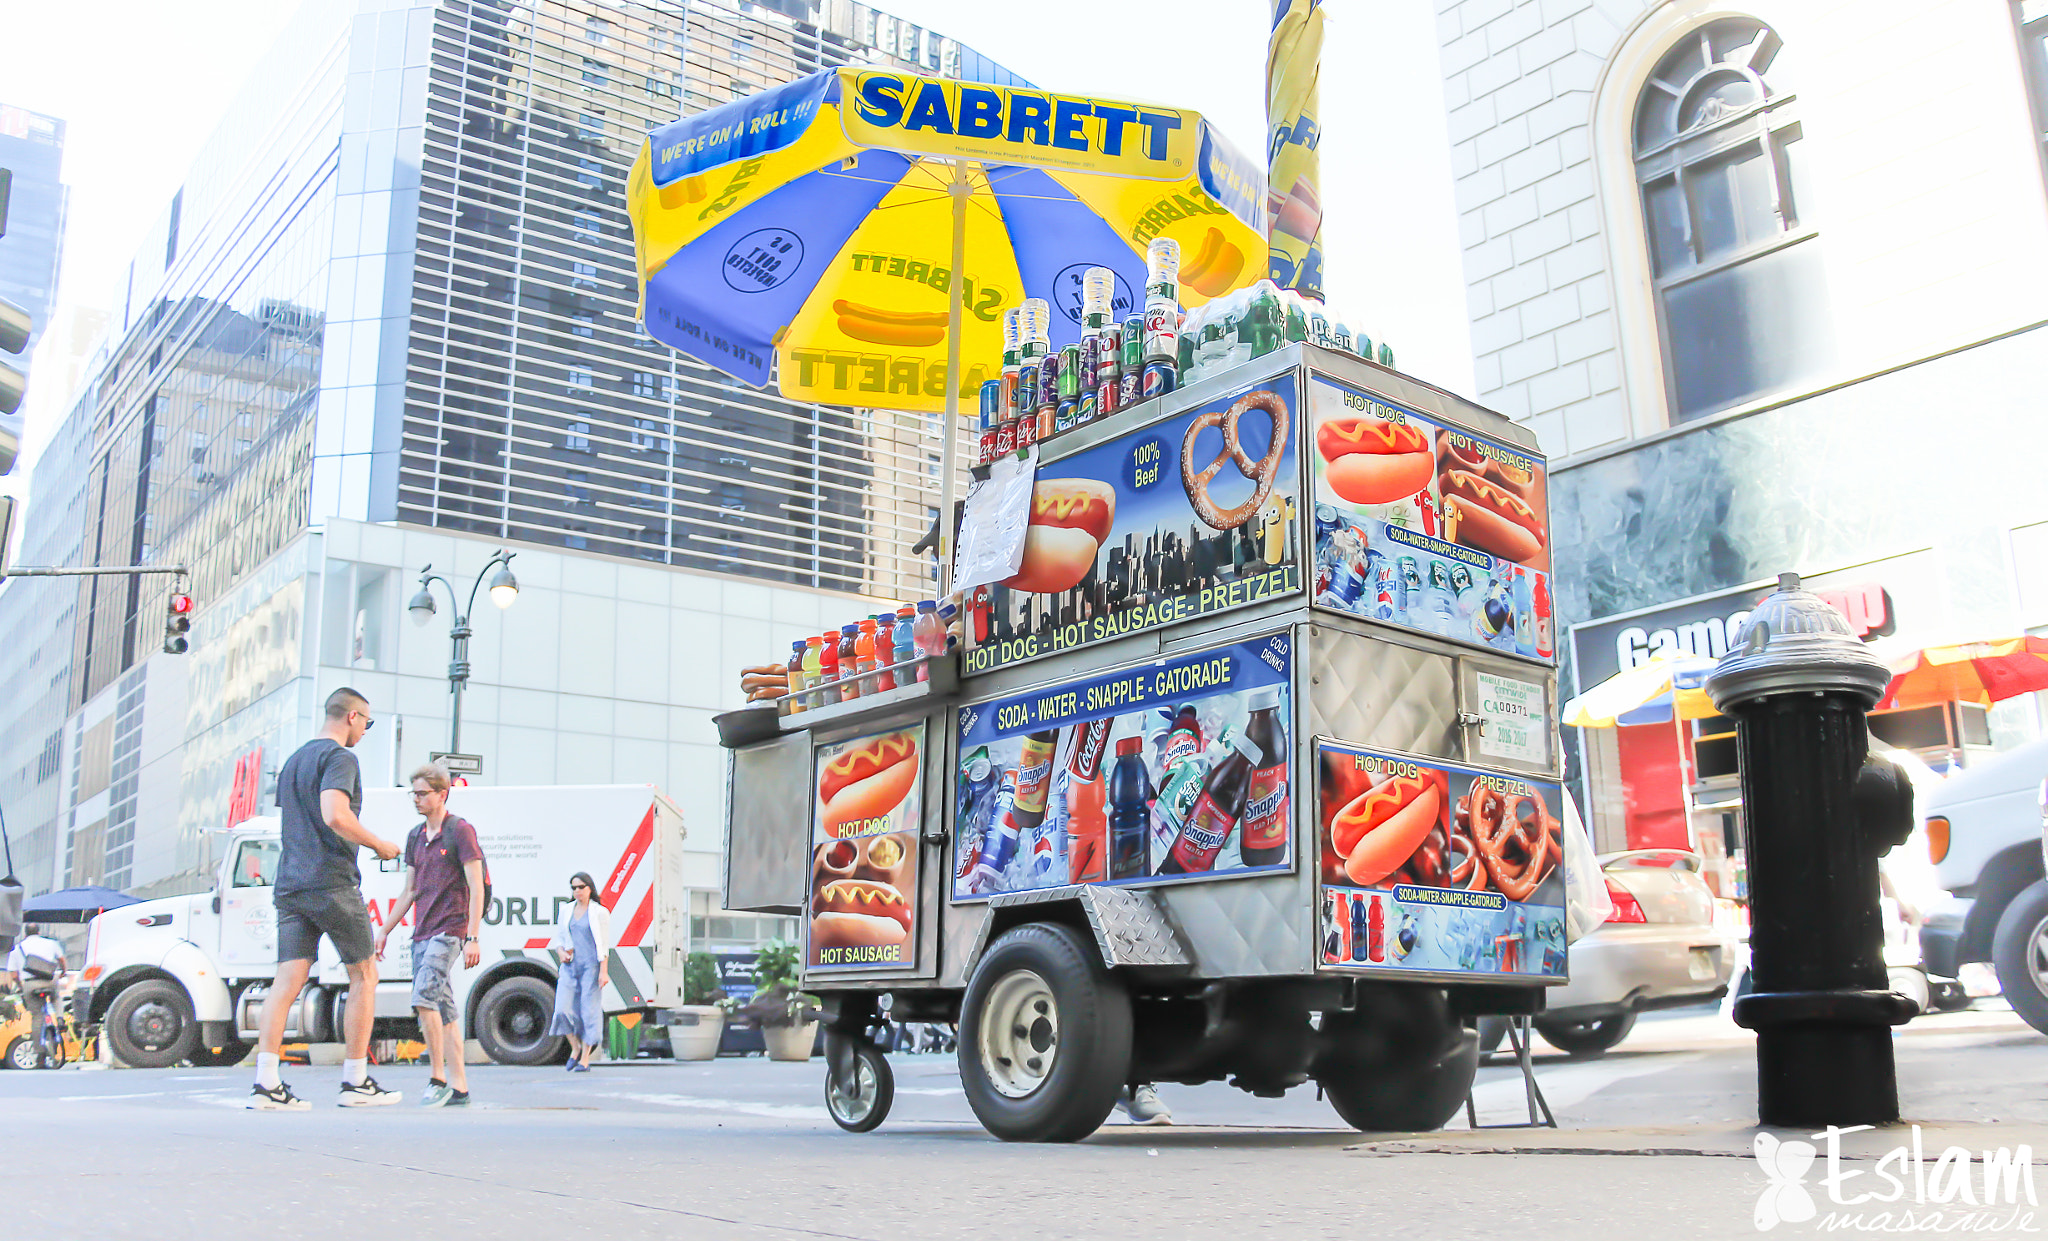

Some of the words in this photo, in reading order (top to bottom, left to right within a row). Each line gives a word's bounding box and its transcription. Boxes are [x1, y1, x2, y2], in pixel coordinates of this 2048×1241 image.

[855, 70, 1181, 161] SABRETT
[661, 135, 706, 165] WE'RE
[709, 124, 732, 147] ON
[734, 121, 745, 139] A
[749, 109, 788, 134] ROLL
[1343, 390, 1373, 414] HOT
[1376, 402, 1406, 426] DOG
[1133, 440, 1160, 467] 100%
[1447, 430, 1473, 451] HOT
[1475, 440, 1533, 473] SAUSAGE
[1134, 467, 1159, 488] Beef
[966, 645, 998, 673] HOT
[1001, 632, 1038, 664] DOG
[1053, 620, 1090, 652] HOT
[1200, 568, 1297, 614] PRETZEL
[1270, 636, 1288, 655] COLD
[1260, 647, 1285, 672] DRINKS
[998, 703, 1029, 730] SODA
[1037, 692, 1077, 722] WATER
[1087, 676, 1145, 712] SNAPPLE
[1155, 657, 1231, 697] GATORADE
[1480, 675, 1501, 685] MOBILE
[1503, 679, 1518, 689] FOOD
[1494, 686, 1527, 700] CITYWIDE
[960, 707, 972, 725] COLD
[962, 712, 979, 736] DRINKS
[1165, 741, 1196, 763] Snapple
[1018, 760, 1051, 784] Snapple
[1353, 753, 1384, 773] HOT
[1387, 758, 1418, 779] DOG
[1479, 774, 1533, 798] PRETZEL
[1245, 781, 1285, 820] Snapple
[838, 820, 861, 839] HOT
[863, 814, 890, 836] DOG
[1183, 819, 1225, 847] Snapple
[820, 947, 843, 964] HOT
[845, 944, 900, 963] SAUSAGE
